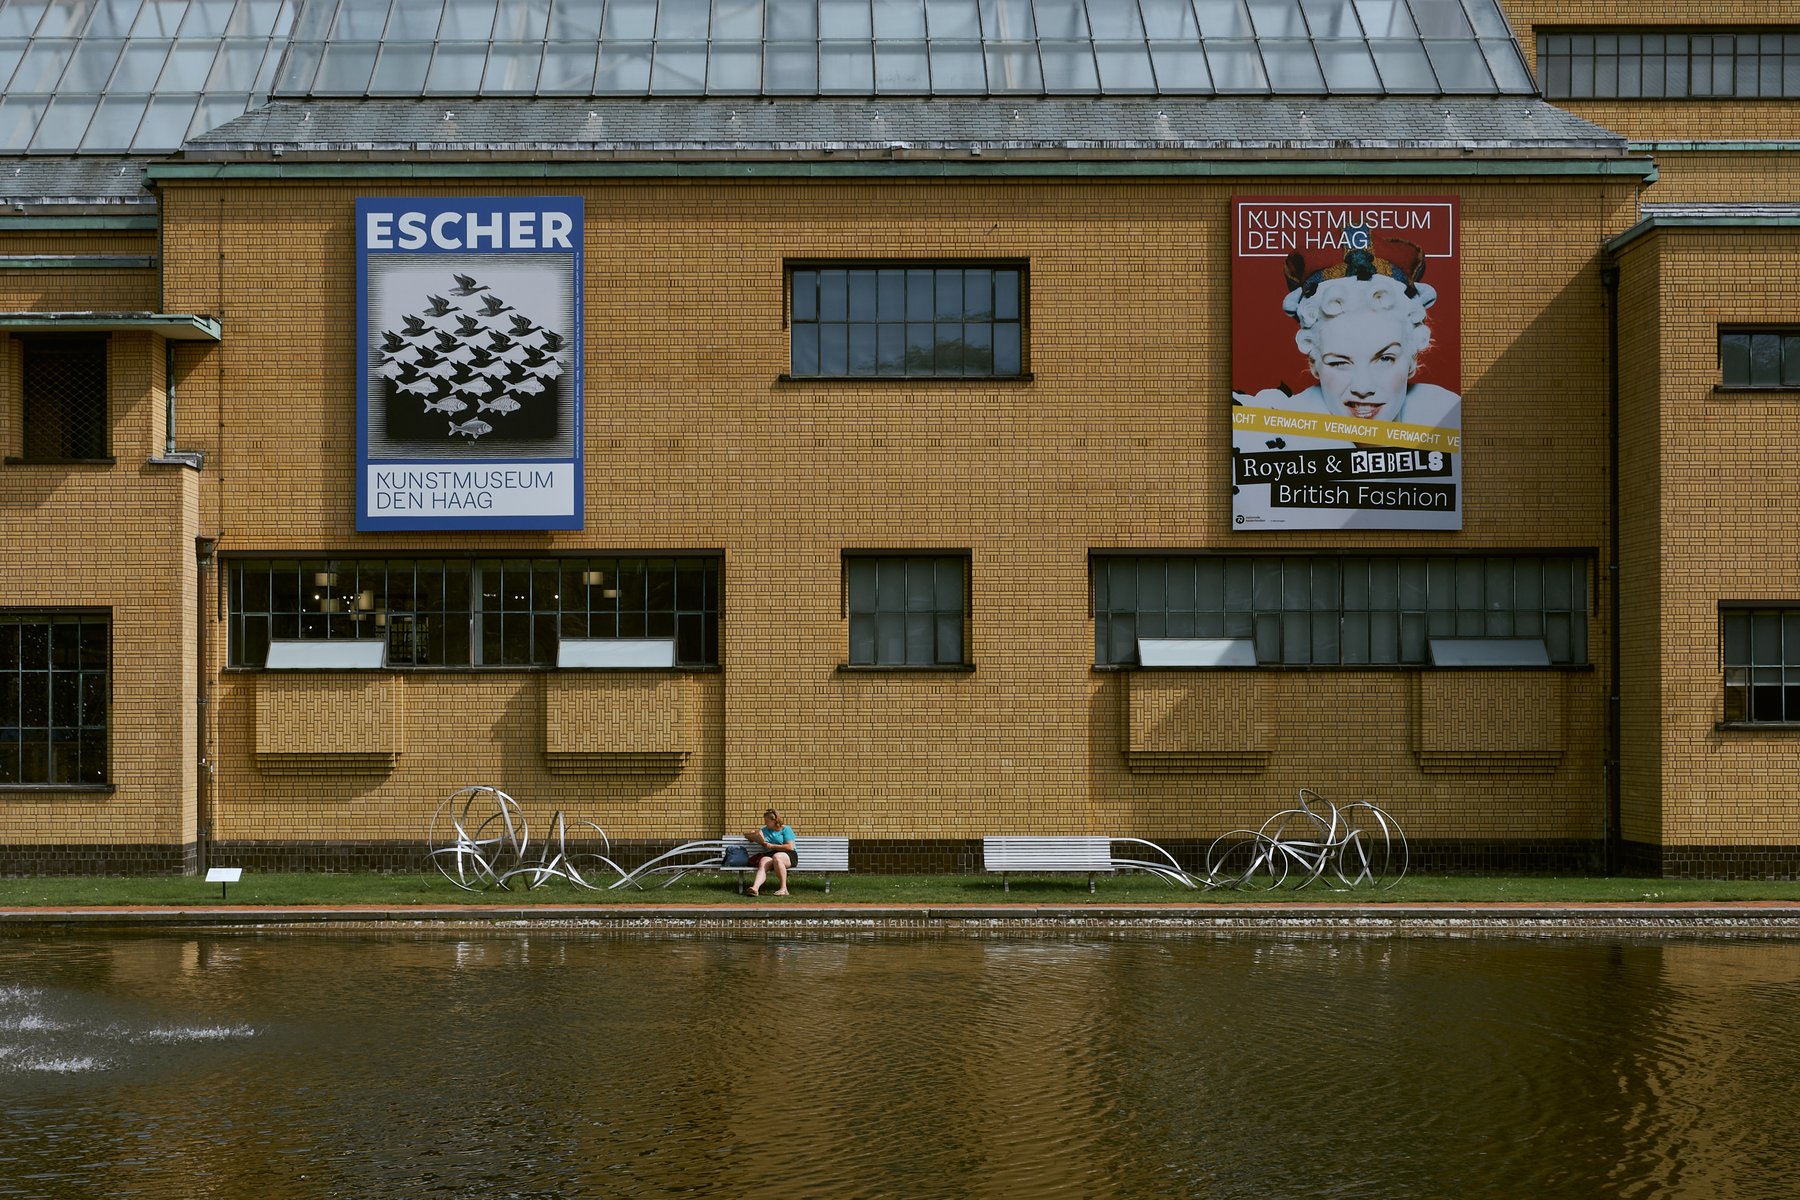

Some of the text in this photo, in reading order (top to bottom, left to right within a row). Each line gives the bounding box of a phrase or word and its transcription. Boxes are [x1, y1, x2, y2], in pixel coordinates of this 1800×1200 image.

[1248, 210, 1431, 229] KUNSTMUSEUM
[366, 211, 574, 250] ESCHER
[1248, 231, 1368, 249] DEN HAAG
[1263, 415, 1318, 430] VERWACHT
[1324, 421, 1378, 437] VERWACHT
[1386, 428, 1440, 445] VERWACHT
[1447, 435, 1460, 447] VE
[1243, 451, 1444, 481] Royals & REBELS
[376, 471, 553, 489] KUNSTMUSEUM
[376, 491, 493, 509] DEN HAAG
[1279, 484, 1447, 507] British Fashion
